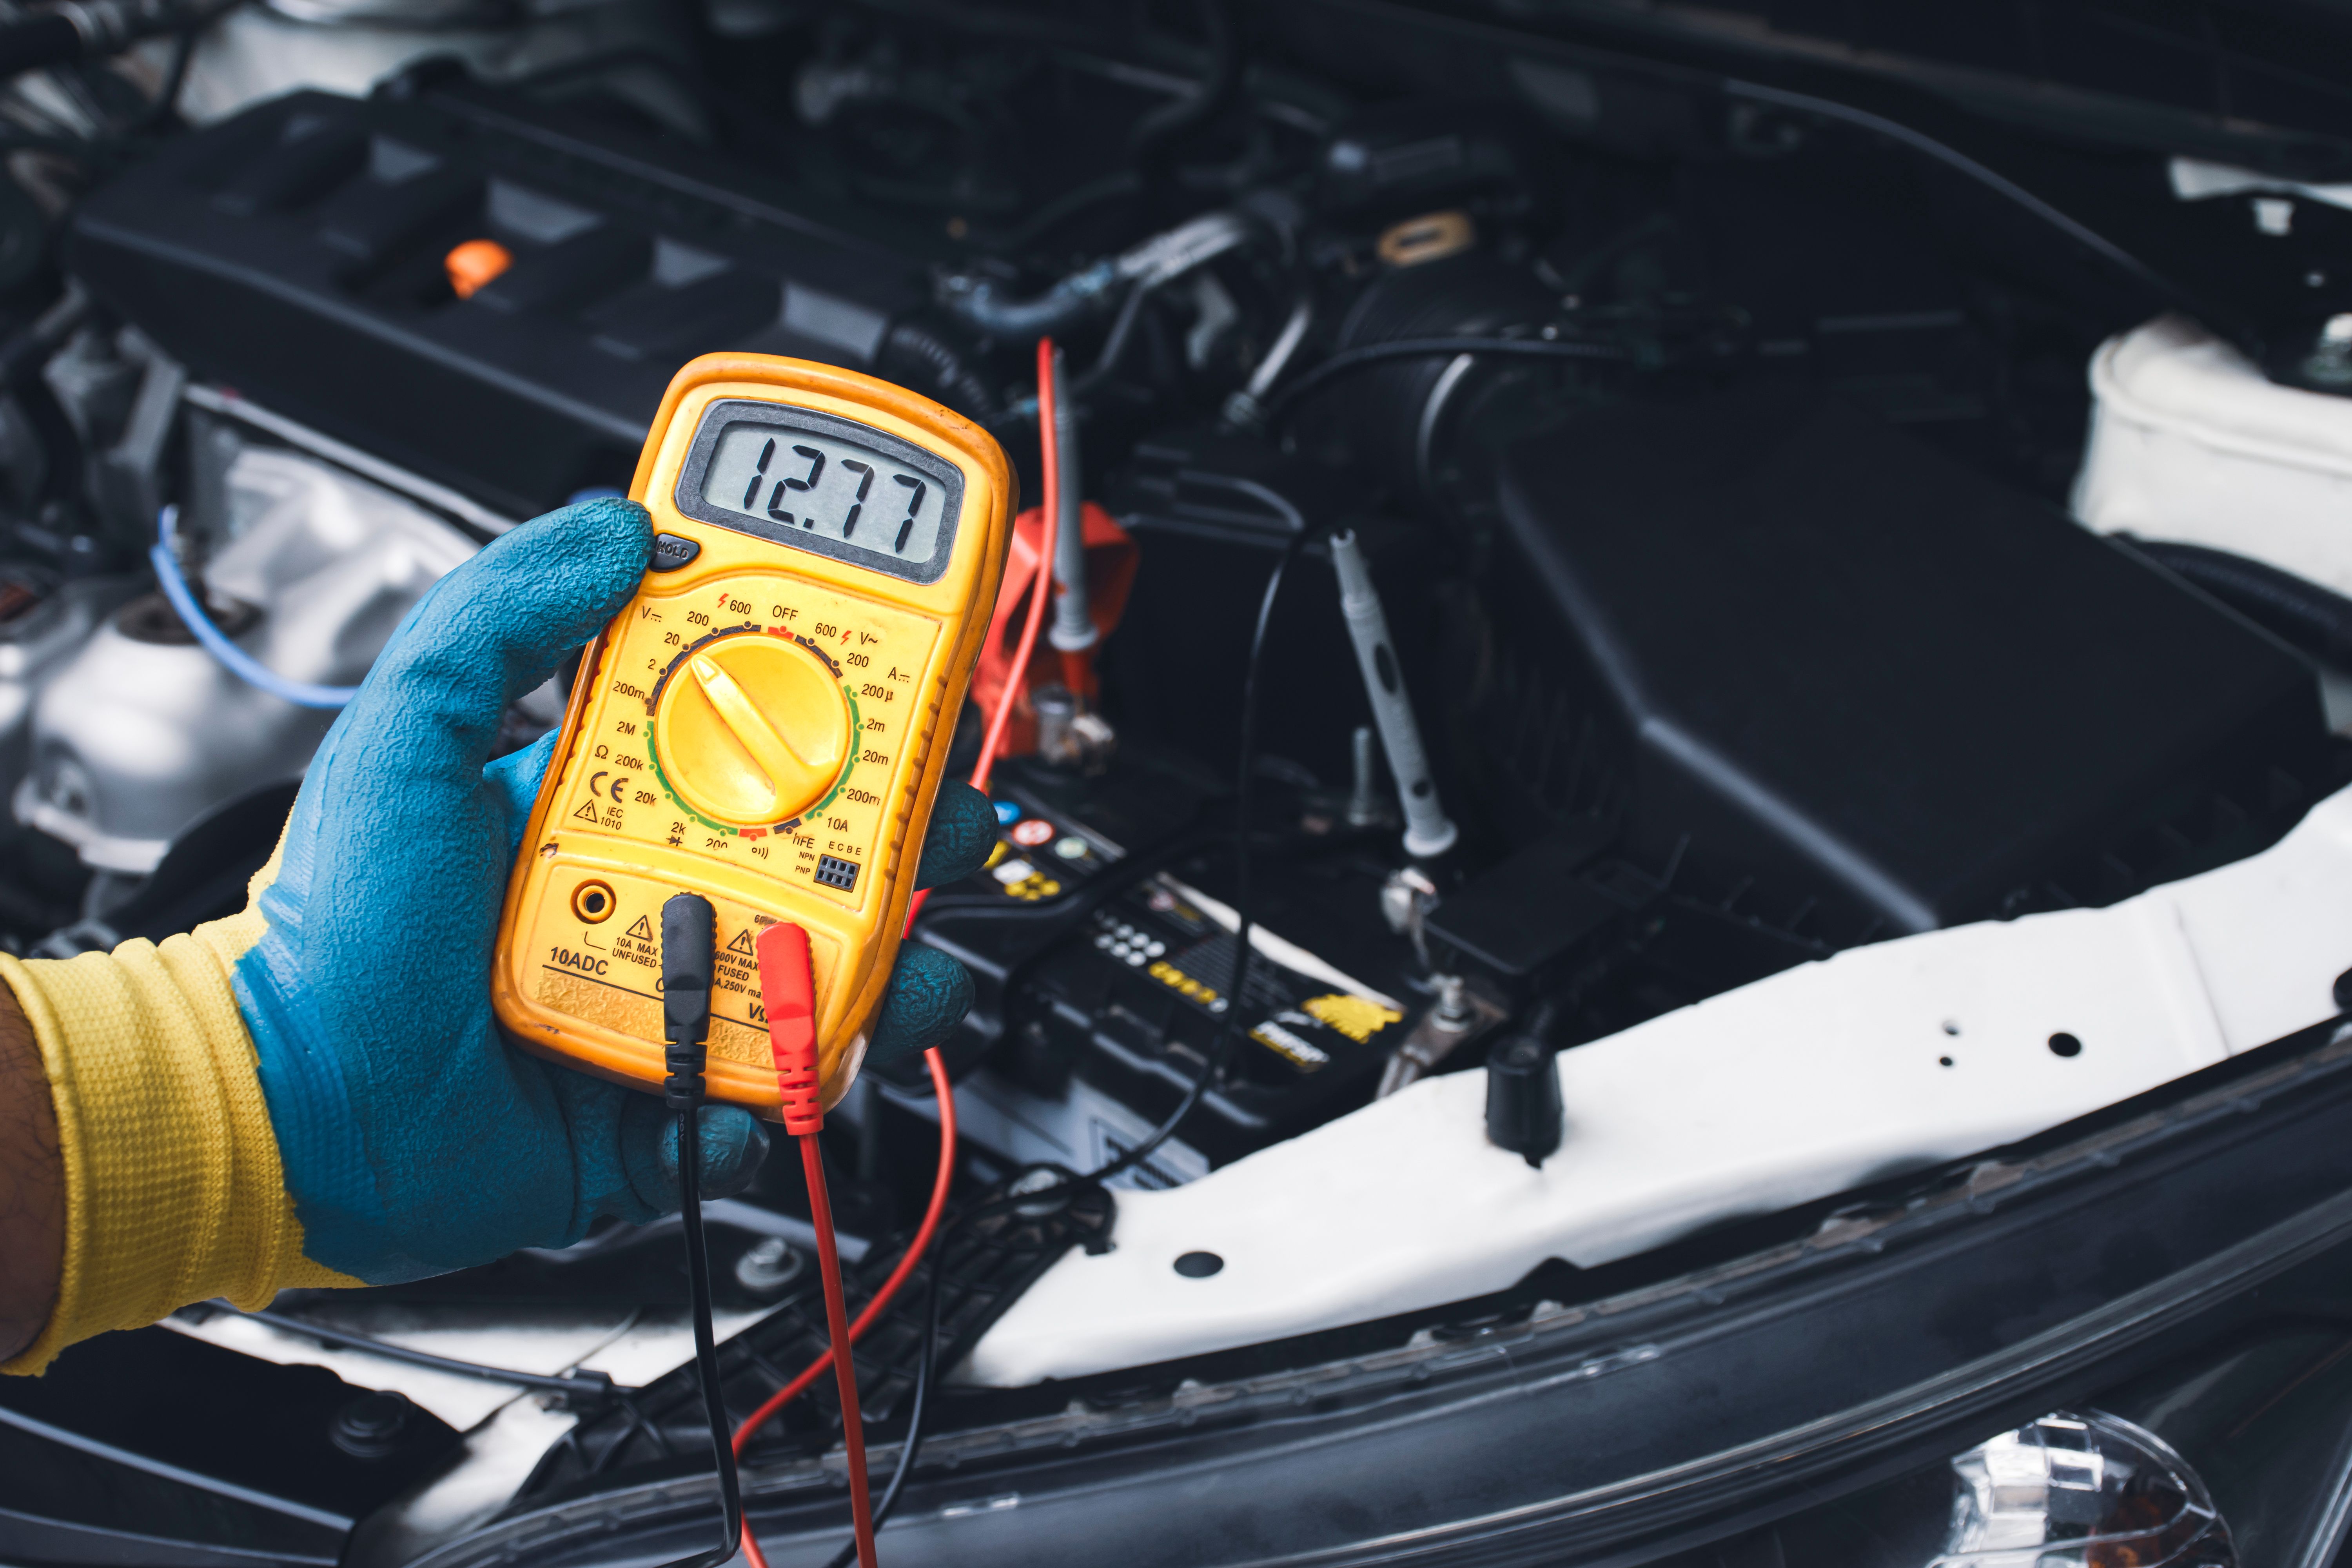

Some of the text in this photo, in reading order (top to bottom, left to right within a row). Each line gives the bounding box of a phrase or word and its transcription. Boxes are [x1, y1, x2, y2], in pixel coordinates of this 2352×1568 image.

[744, 437, 926, 553] 12.77
[657, 541, 689, 559] HOLD
[730, 599, 751, 615] 600
[772, 605, 799, 621] OFF
[686, 611, 709, 626] 200
[815, 623, 837, 637] 600
[664, 632, 680, 646] 20
[648, 659, 656, 670] 2
[847, 652, 869, 667] 200
[613, 681, 645, 700] 200m
[617, 721, 636, 735] 2M
[866, 718, 885, 732] 2m
[595, 745, 608, 759] Ω
[862, 750, 888, 765] 20m
[615, 754, 644, 771] 200k
[635, 791, 657, 806] 20k
[847, 788, 880, 806] 200m
[606, 806, 623, 818] IEC
[601, 817, 621, 830] 1010
[671, 822, 686, 835] 2k
[828, 817, 848, 832] 10A
[793, 833, 815, 849] hFE
[799, 851, 815, 861] NPN
[795, 866, 810, 875] PNP
[616, 937, 658, 956] 10A MAX
[551, 947, 608, 975] 10ADC
[612, 948, 657, 968] UNFUSED
[715, 951, 759, 971] 600V MAX
[718, 964, 749, 981] FUSED
[748, 989, 761, 998] ma
